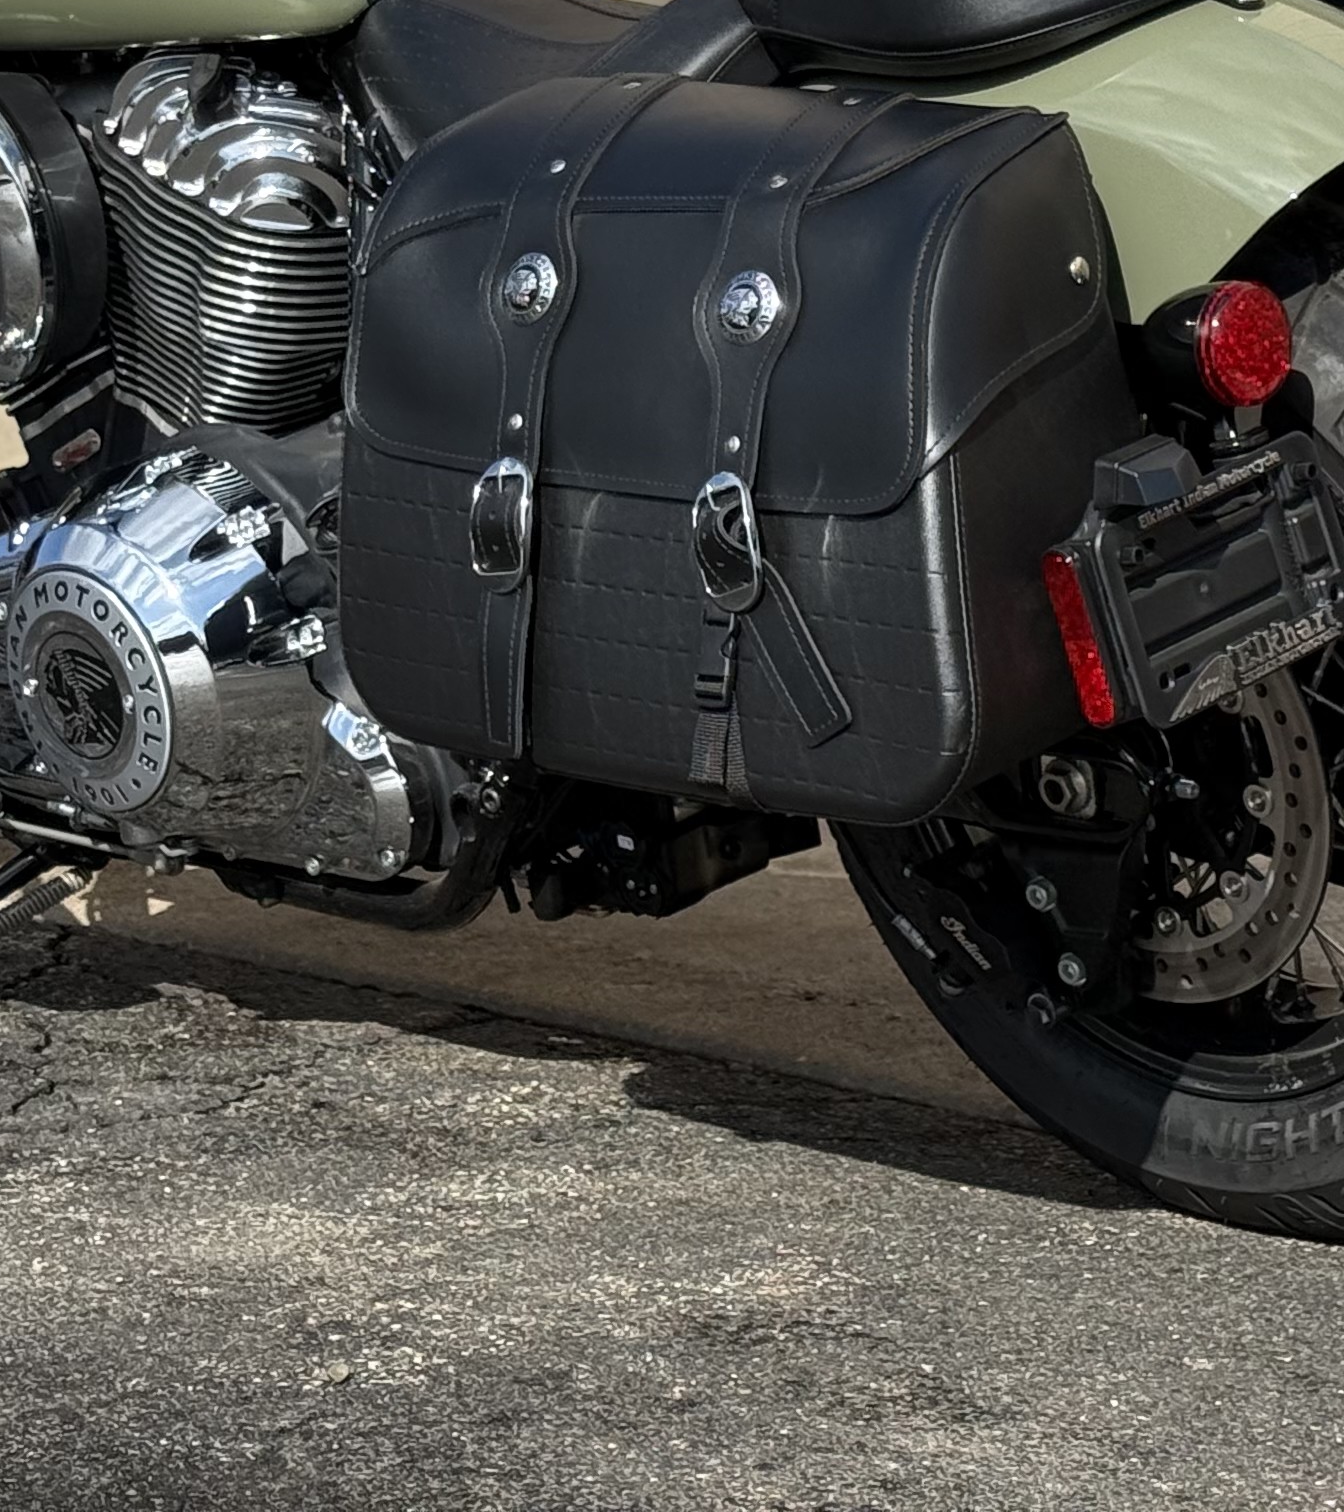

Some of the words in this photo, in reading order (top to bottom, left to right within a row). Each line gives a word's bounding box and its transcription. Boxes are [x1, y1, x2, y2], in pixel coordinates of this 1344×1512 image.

[1229, 600, 1344, 672] Elkhart
[33, 580, 162, 774] MOTORCYCLE
[940, 915, 993, 972] Indian
